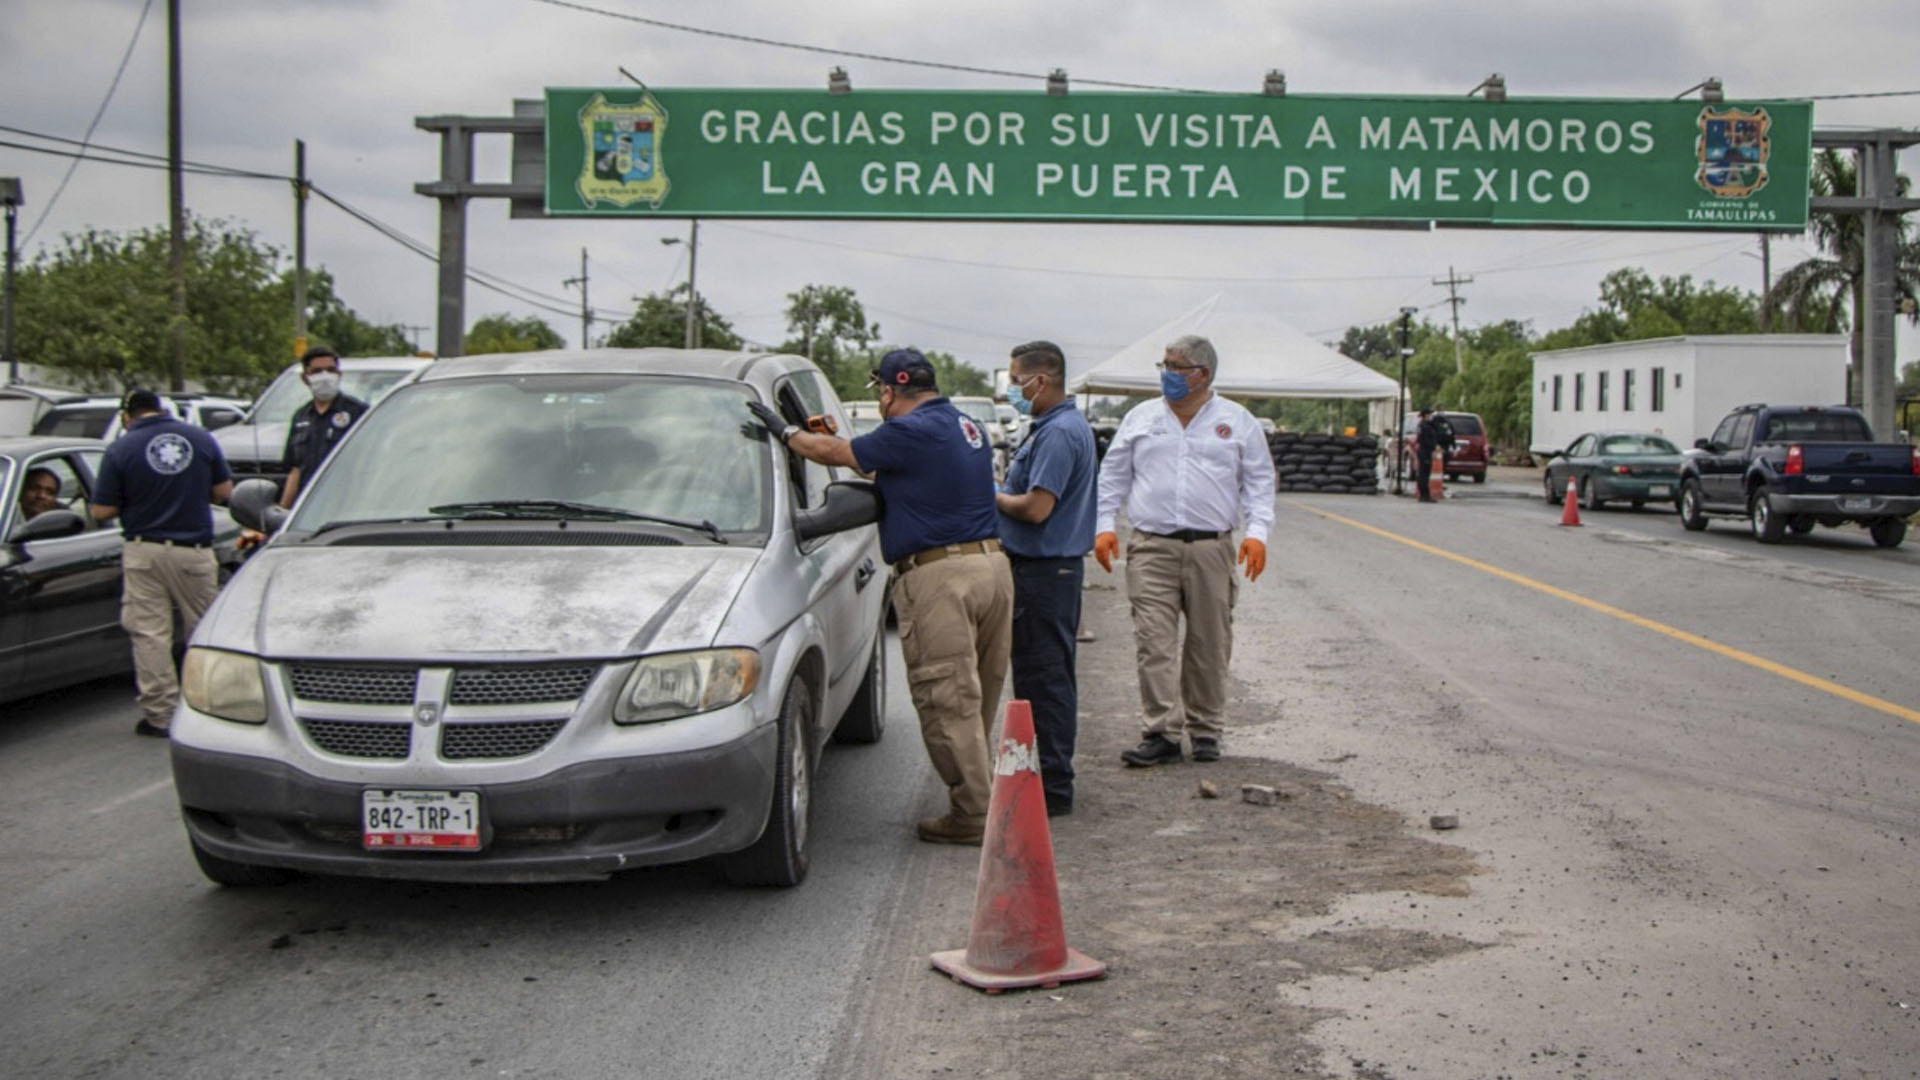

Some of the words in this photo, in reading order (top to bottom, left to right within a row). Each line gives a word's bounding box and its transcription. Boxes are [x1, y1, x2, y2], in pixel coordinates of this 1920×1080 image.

[701, 110, 905, 145] GRACIAS
[931, 111, 1026, 147] POR
[1051, 113, 1111, 148] SU
[1135, 113, 1282, 149] VISITA
[1305, 115, 1336, 150] A
[1360, 116, 1655, 154] MATAMOROS
[763, 160, 826, 195] LA
[861, 161, 995, 197] GRAN
[1037, 163, 1239, 199] PUERTA
[1284, 165, 1347, 201] DE
[1390, 167, 1591, 204] MEXICO
[1687, 209, 1776, 220] TAMAULIPAS
[369, 806, 472, 829] 842-TRP-1
